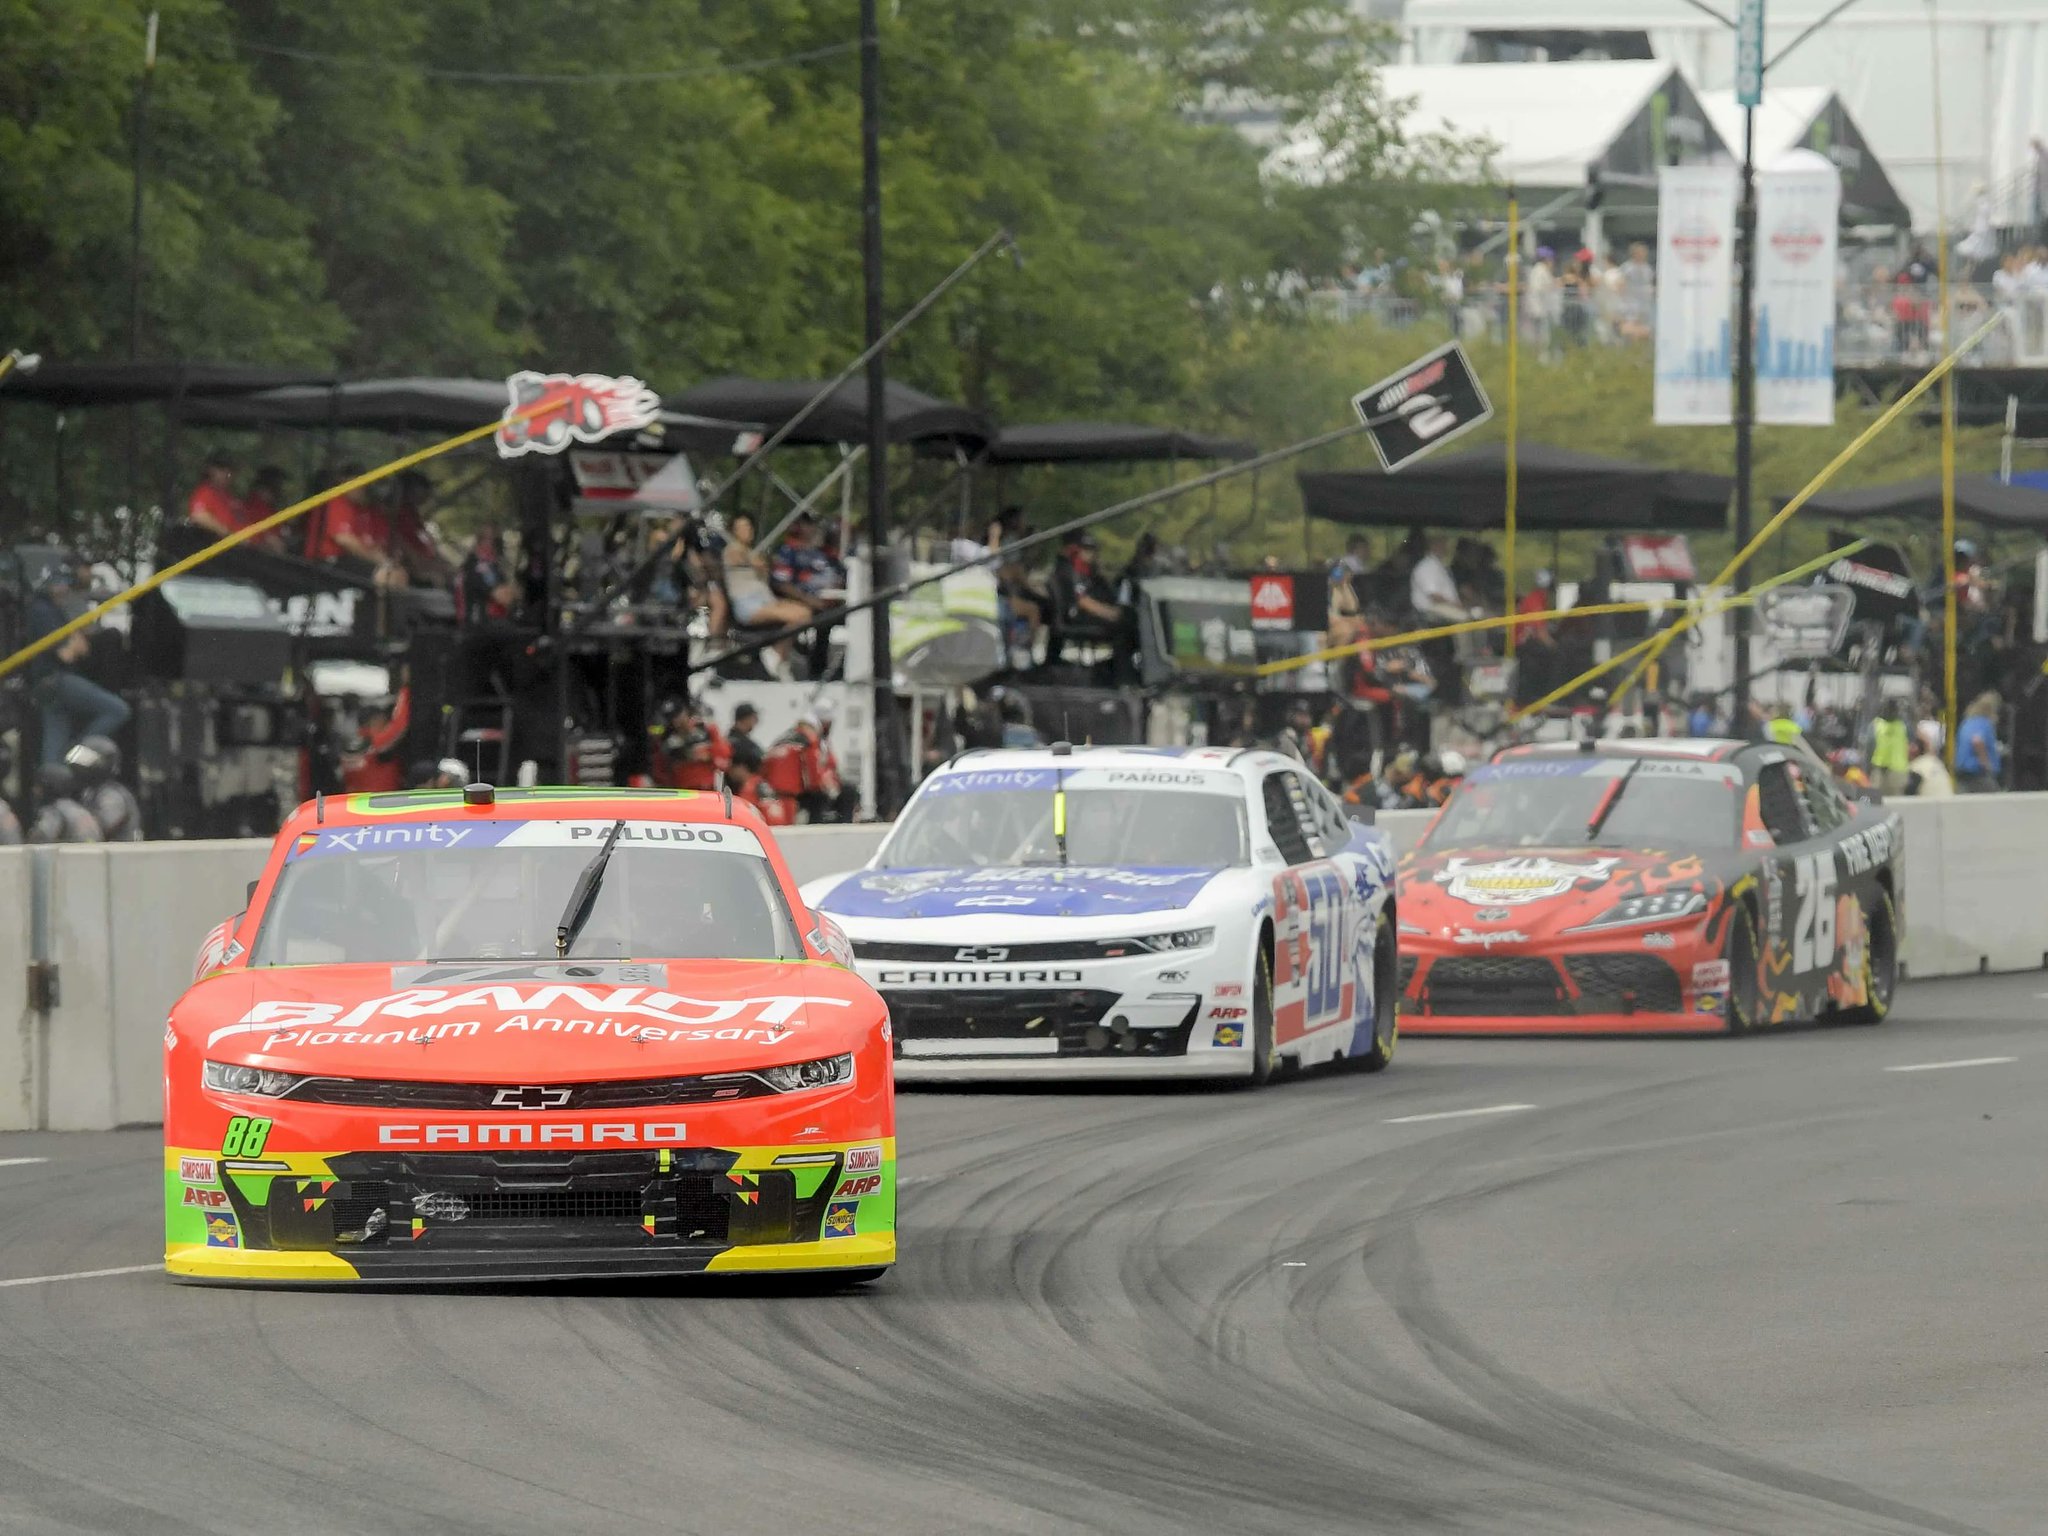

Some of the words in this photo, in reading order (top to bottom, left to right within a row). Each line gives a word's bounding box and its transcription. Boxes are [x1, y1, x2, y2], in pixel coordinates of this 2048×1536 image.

[944, 770, 1043, 791] xfinity
[1108, 772, 1206, 785] PARDUS
[327, 824, 473, 852] xfinity
[571, 826, 723, 844] PALUDO
[1793, 850, 1838, 974] 26
[878, 970, 1083, 984] CAMARO
[207, 985, 852, 1050] BRANDT
[1208, 1007, 1248, 1019] ARP
[263, 1021, 480, 1052] Platinum
[497, 1015, 795, 1045] Anniversary
[222, 1116, 273, 1157] 88
[378, 1123, 687, 1144] CAMARO
[182, 1160, 212, 1180] SIMPSON
[849, 1151, 880, 1170] SIMPSON
[835, 1174, 882, 1196] ARP
[183, 1186, 227, 1207] ARP
[827, 1214, 855, 1226] SUNOCO
